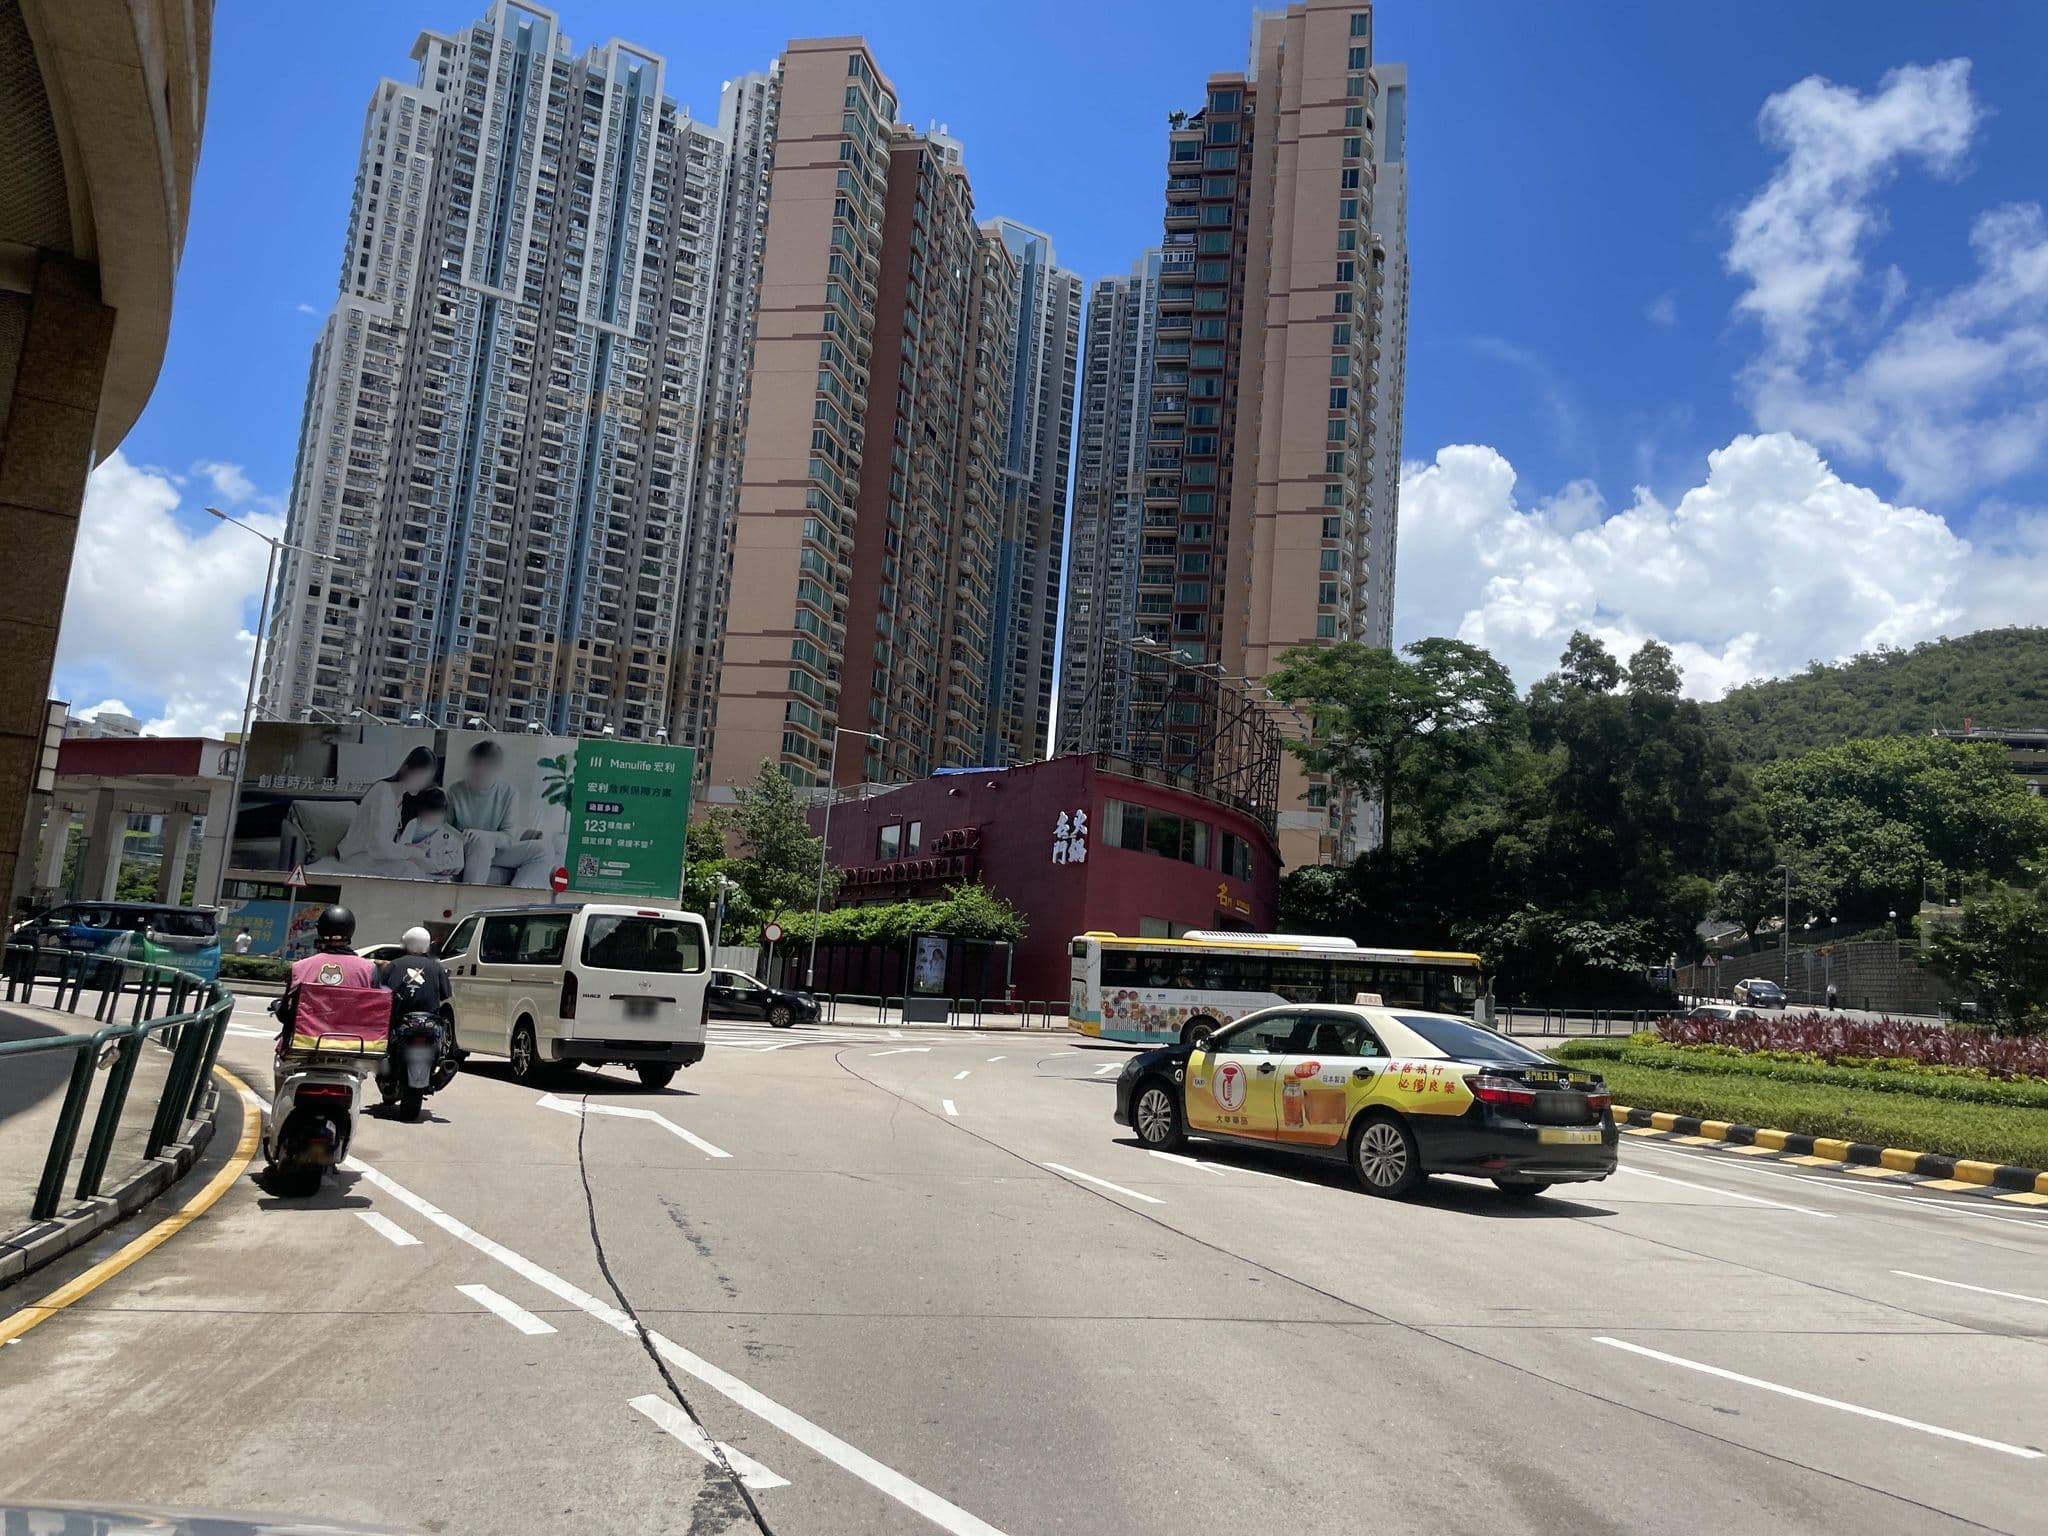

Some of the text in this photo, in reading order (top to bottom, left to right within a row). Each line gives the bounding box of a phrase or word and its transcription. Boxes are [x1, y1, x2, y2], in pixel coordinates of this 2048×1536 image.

[610, 758, 675, 773] Manulife 宏利
[258, 774, 316, 790] 創造時光
[1194, 1078, 1205, 1086] TAXI
